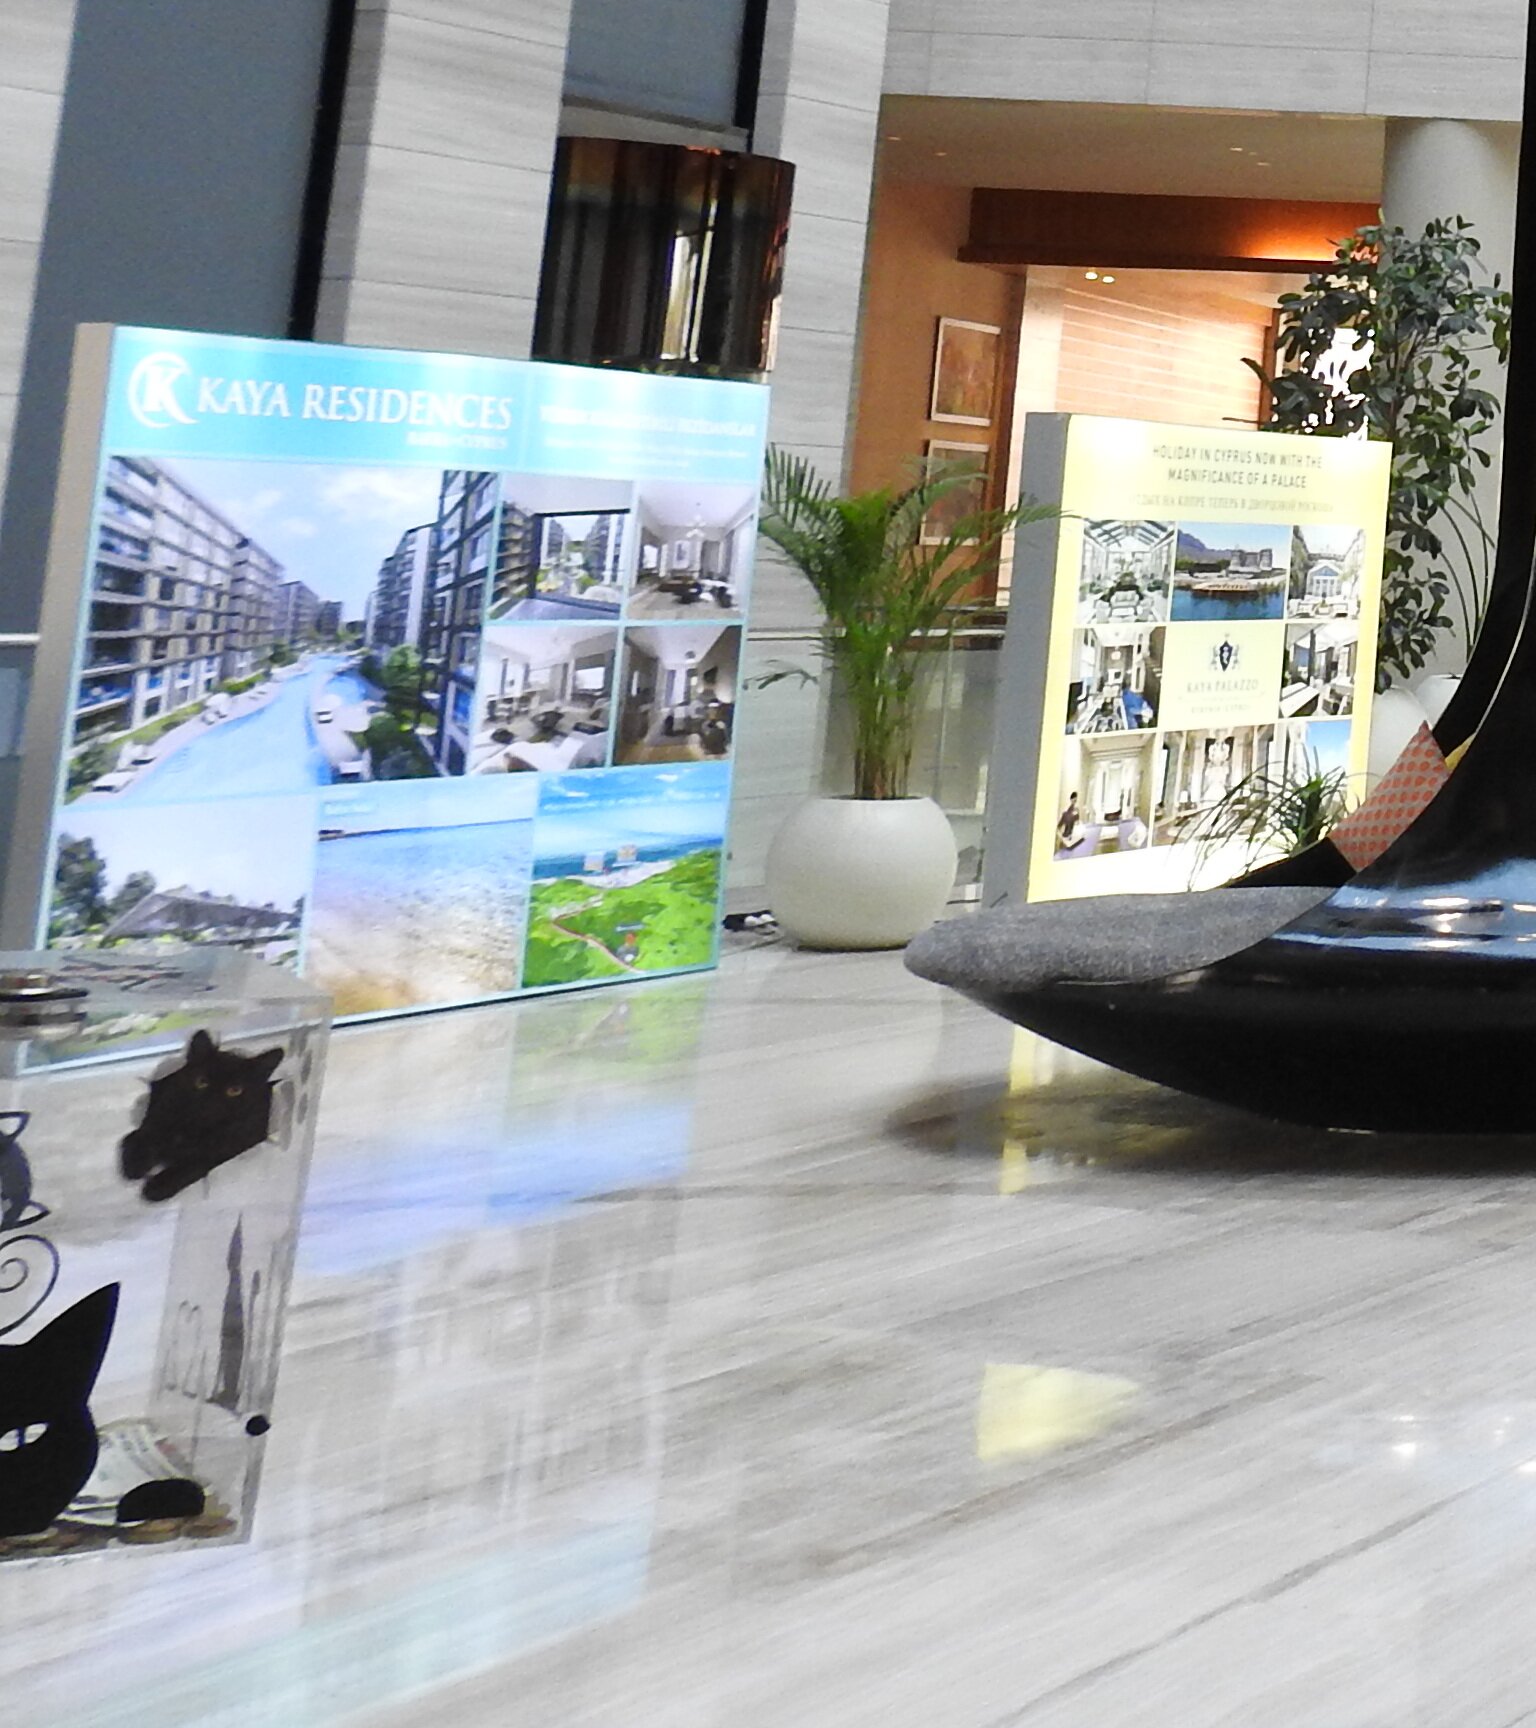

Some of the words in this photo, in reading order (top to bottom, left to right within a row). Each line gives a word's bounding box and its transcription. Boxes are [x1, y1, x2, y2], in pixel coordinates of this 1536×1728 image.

[198, 377, 291, 419] KAYA
[303, 383, 513, 431] RESIDENCES
[1153, 444, 1197, 460] HOLIDAY
[1200, 448, 1211, 461] IN
[1214, 449, 1252, 464] CYPRUS
[1255, 452, 1276, 465] NOW
[1280, 454, 1302, 467] WITH
[1306, 455, 1322, 469] THE
[1168, 468, 1244, 485] MAGNIFICANCE
[1247, 472, 1260, 485] OF
[1262, 473, 1268, 485] A
[1271, 474, 1307, 488] PALACE
[1215, 679, 1259, 692] PALAZZO
